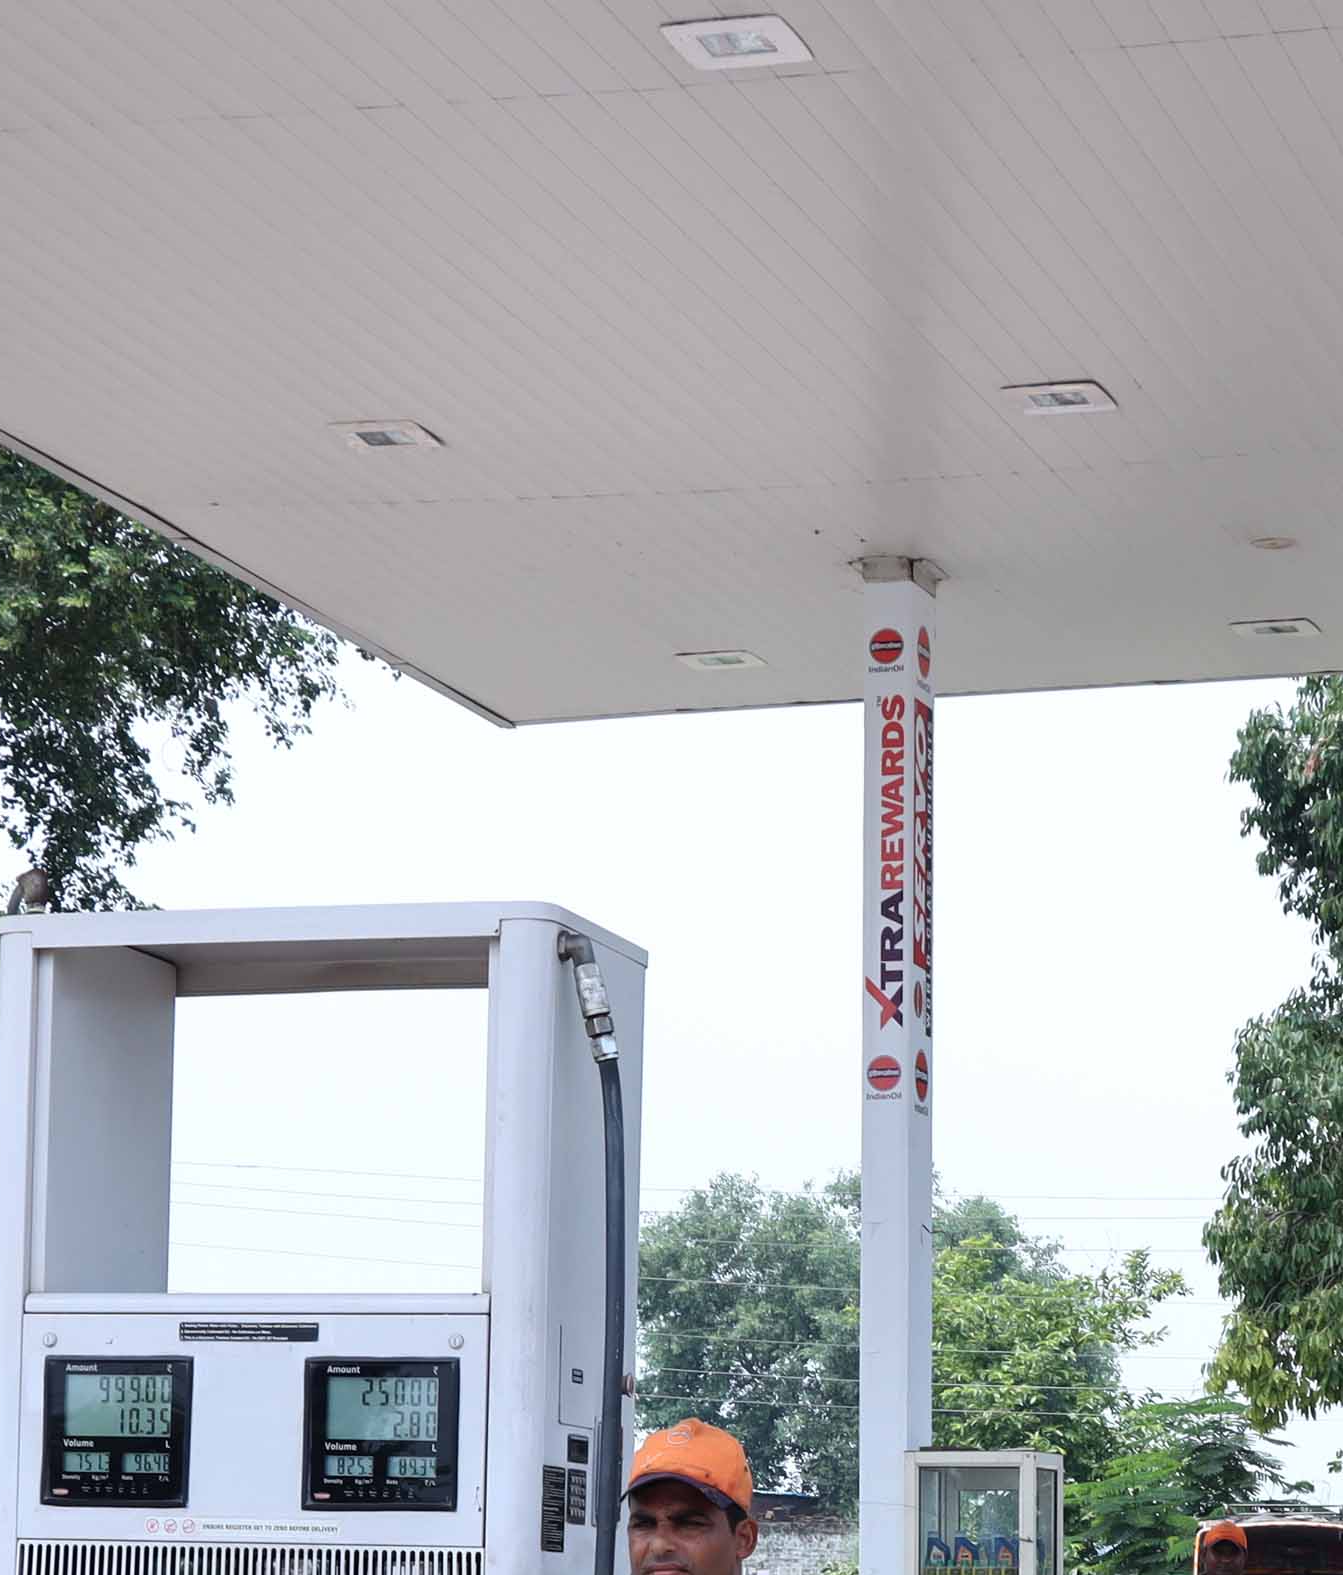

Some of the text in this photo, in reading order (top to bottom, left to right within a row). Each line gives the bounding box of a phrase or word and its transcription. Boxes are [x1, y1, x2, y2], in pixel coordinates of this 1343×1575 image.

[914, 713, 927, 955] SERVO
[65, 1363, 98, 1372] Amount
[326, 1365, 361, 1374] Amount
[393, 1410, 437, 1439] 2.80
[63, 1439, 94, 1448] Volume
[324, 1442, 357, 1451] Volume
